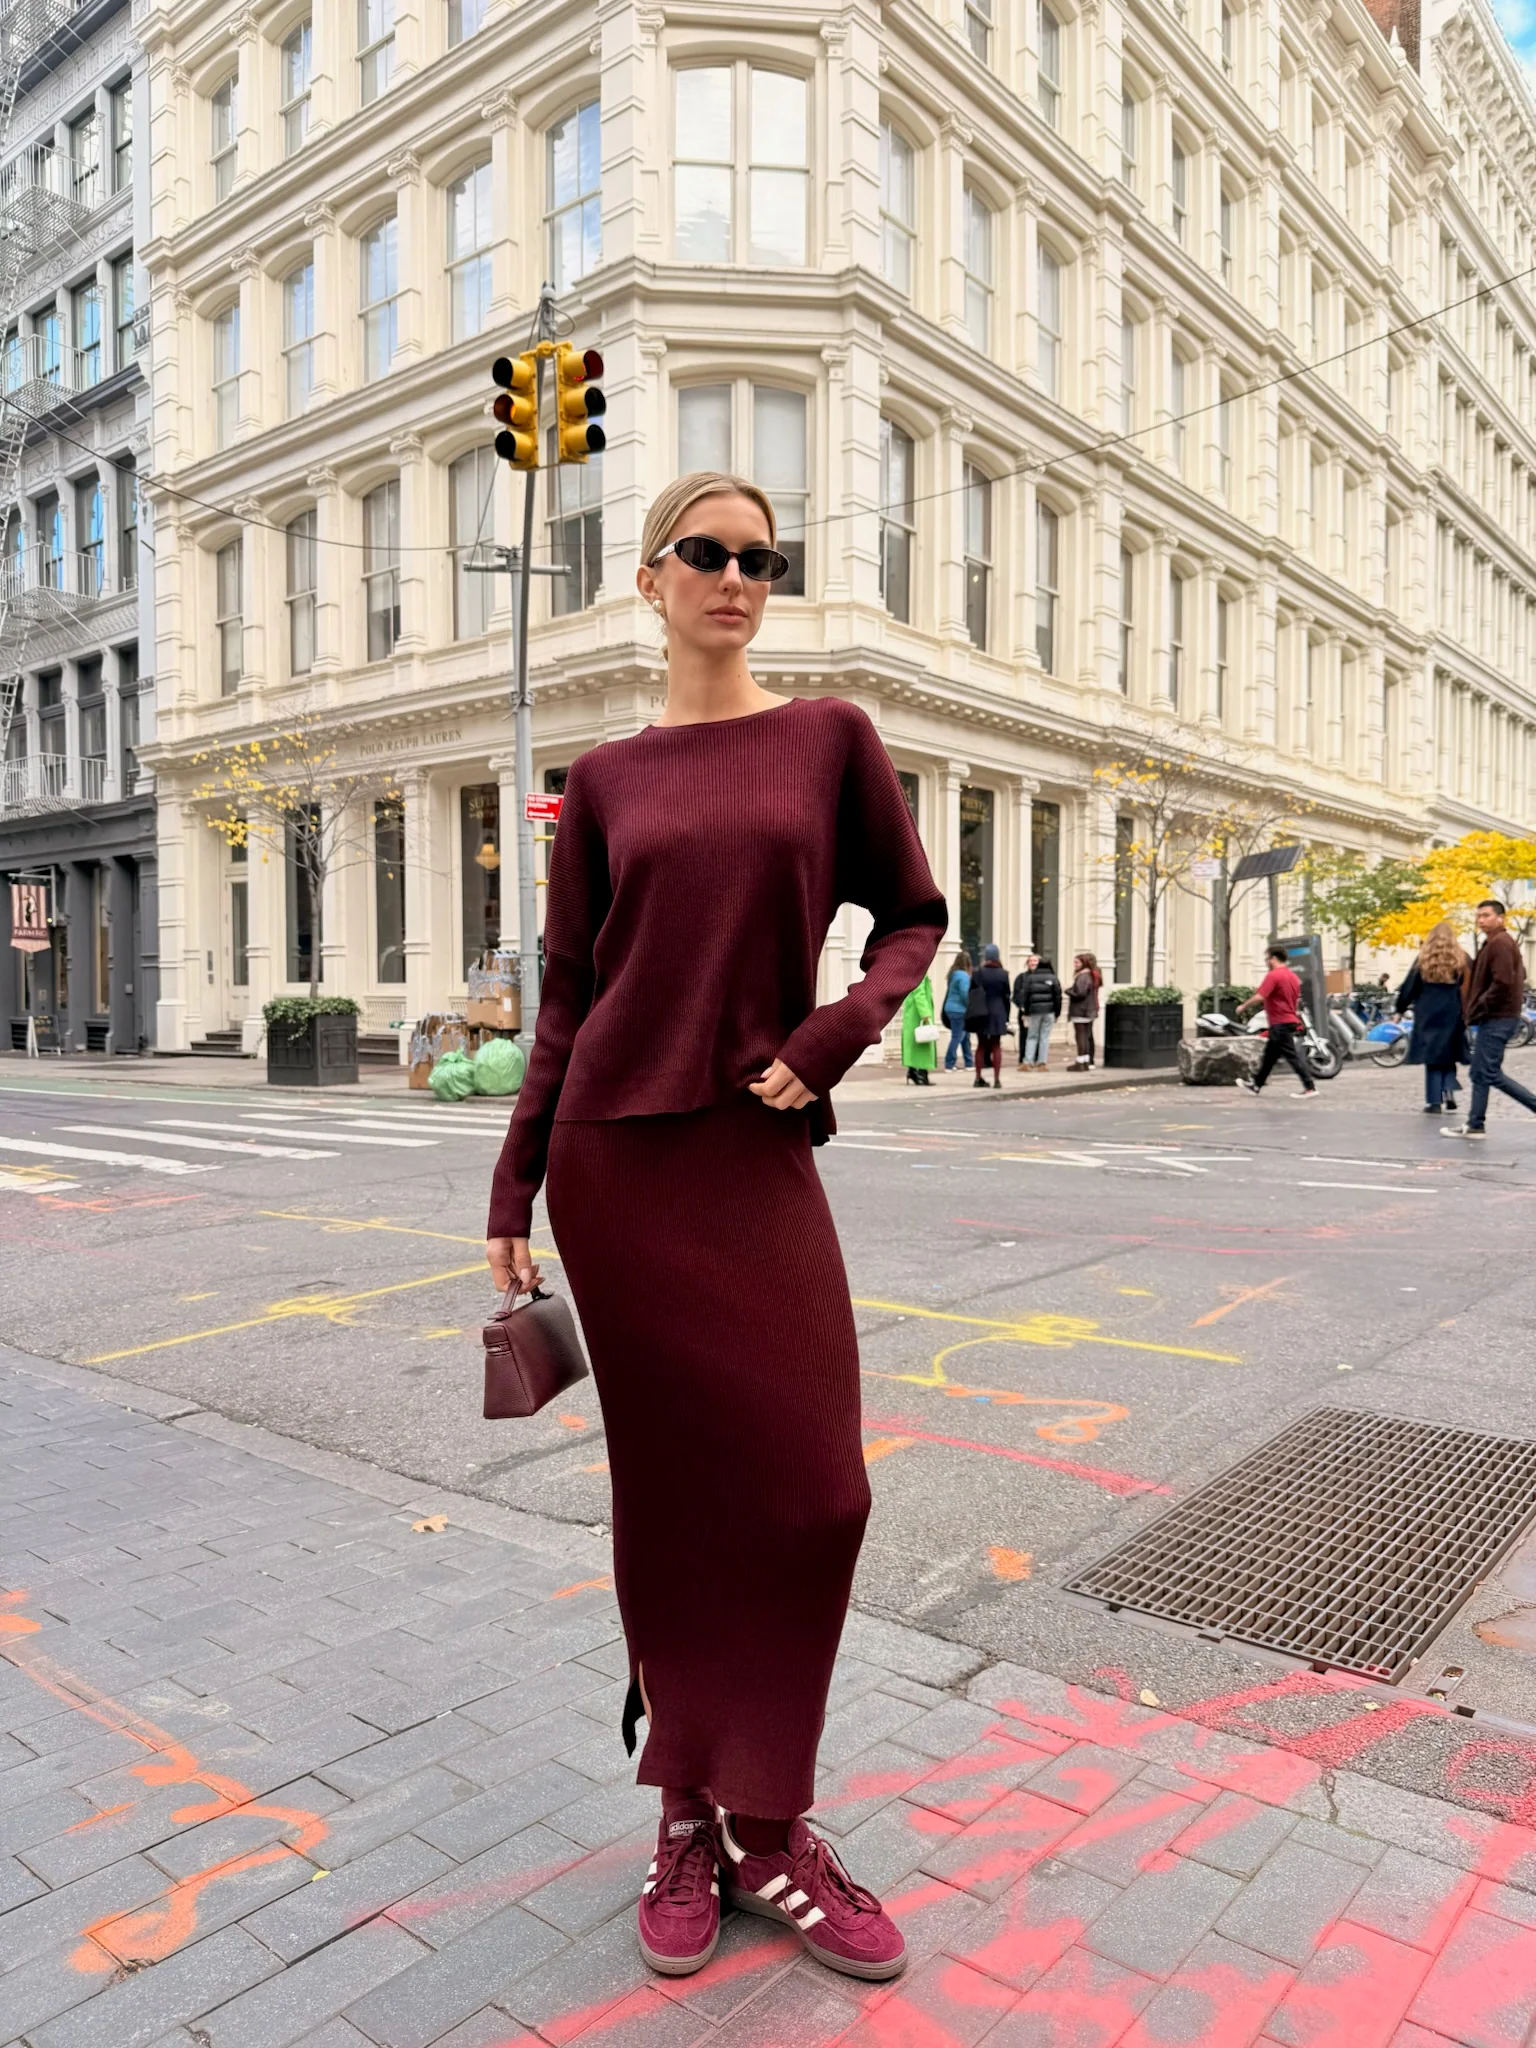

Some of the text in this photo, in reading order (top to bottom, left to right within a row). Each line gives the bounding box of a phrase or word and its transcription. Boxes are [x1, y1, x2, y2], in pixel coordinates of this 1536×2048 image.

[360, 730, 462, 756] POLO RALPH LAUREN
[14, 928, 35, 936] FARM
[670, 1822, 694, 1832] adidas
